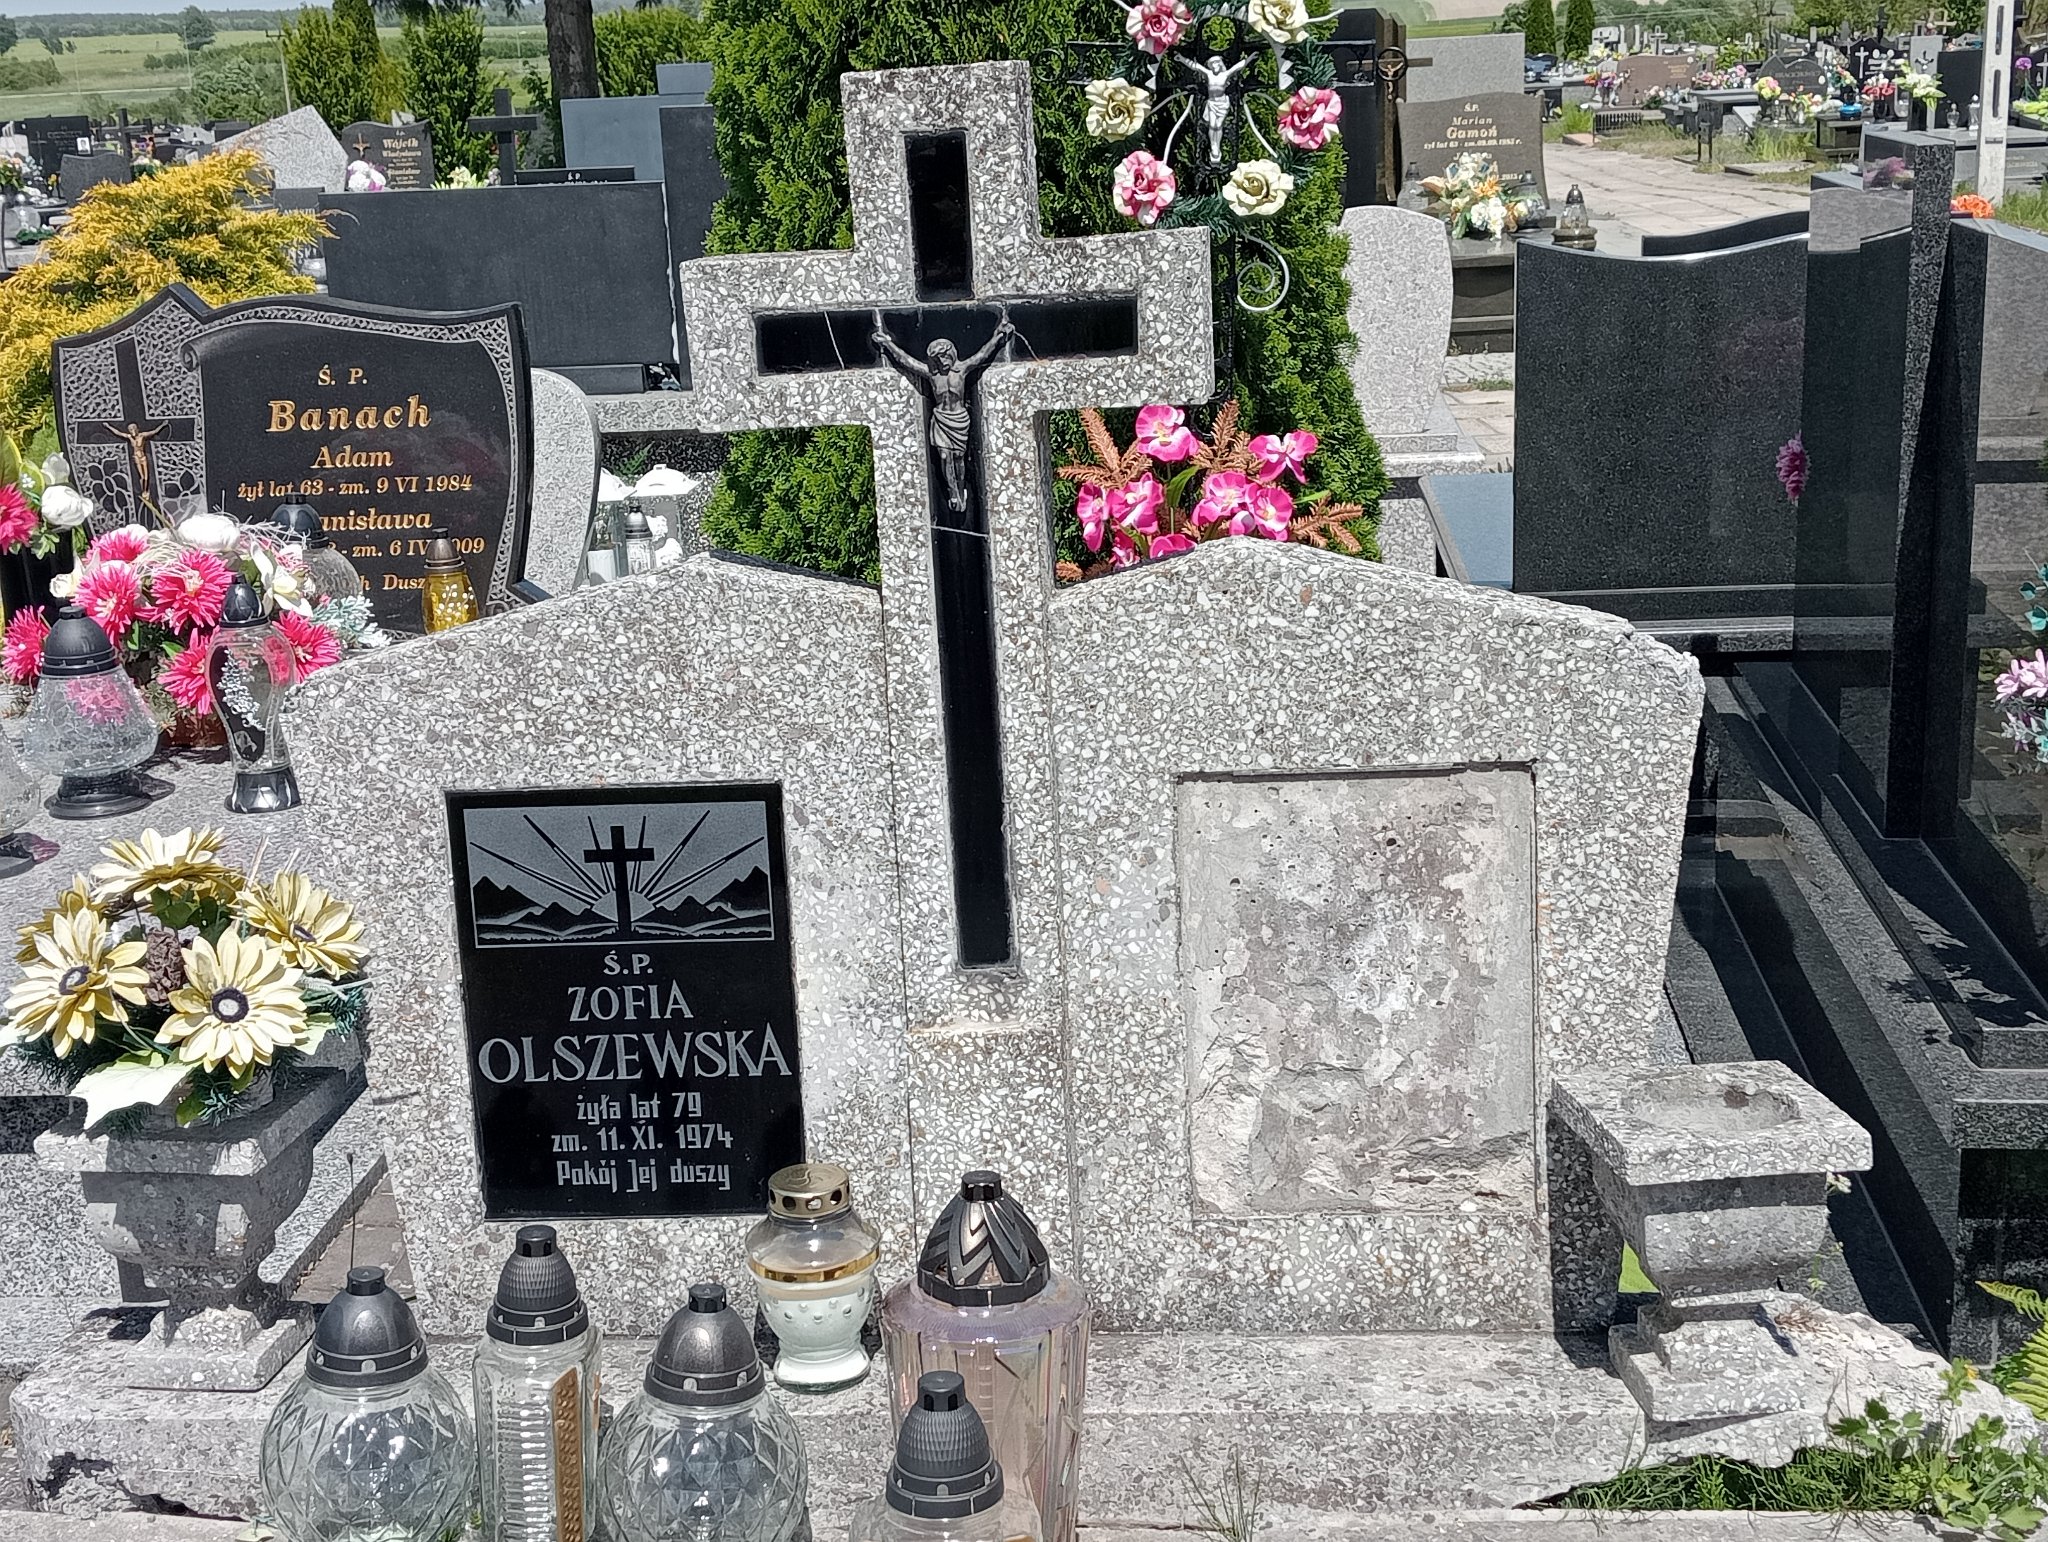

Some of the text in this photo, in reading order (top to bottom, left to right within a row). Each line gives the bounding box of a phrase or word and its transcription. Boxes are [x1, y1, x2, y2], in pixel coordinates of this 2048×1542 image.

[1446, 125, 1498, 139] Gamoń
[1452, 116, 1493, 126] Marian
[318, 364, 368, 386] Ś. P.
[265, 394, 431, 433] Banach
[310, 445, 394, 469] Adam
[237, 481, 265, 502] żył
[269, 480, 294, 497] lat
[300, 478, 324, 496] 63
[338, 482, 370, 495] zm.
[376, 476, 389, 494] 9
[394, 475, 419, 493] VI
[424, 474, 473, 493] 1984
[320, 506, 433, 532] anisława
[352, 545, 382, 557] zm.
[389, 539, 402, 556] 6
[451, 536, 485, 554] 009
[382, 573, 426, 591] Dusz
[603, 950, 654, 976] Ś.P.
[568, 979, 694, 1022] ZOFIA
[478, 1022, 792, 1083] OLSZEWSKA
[576, 1091, 702, 1125] żyła lat 79
[552, 1123, 734, 1153] zm. 11. XI. 1974
[557, 1157, 732, 1193] Pokój Jej duszy
